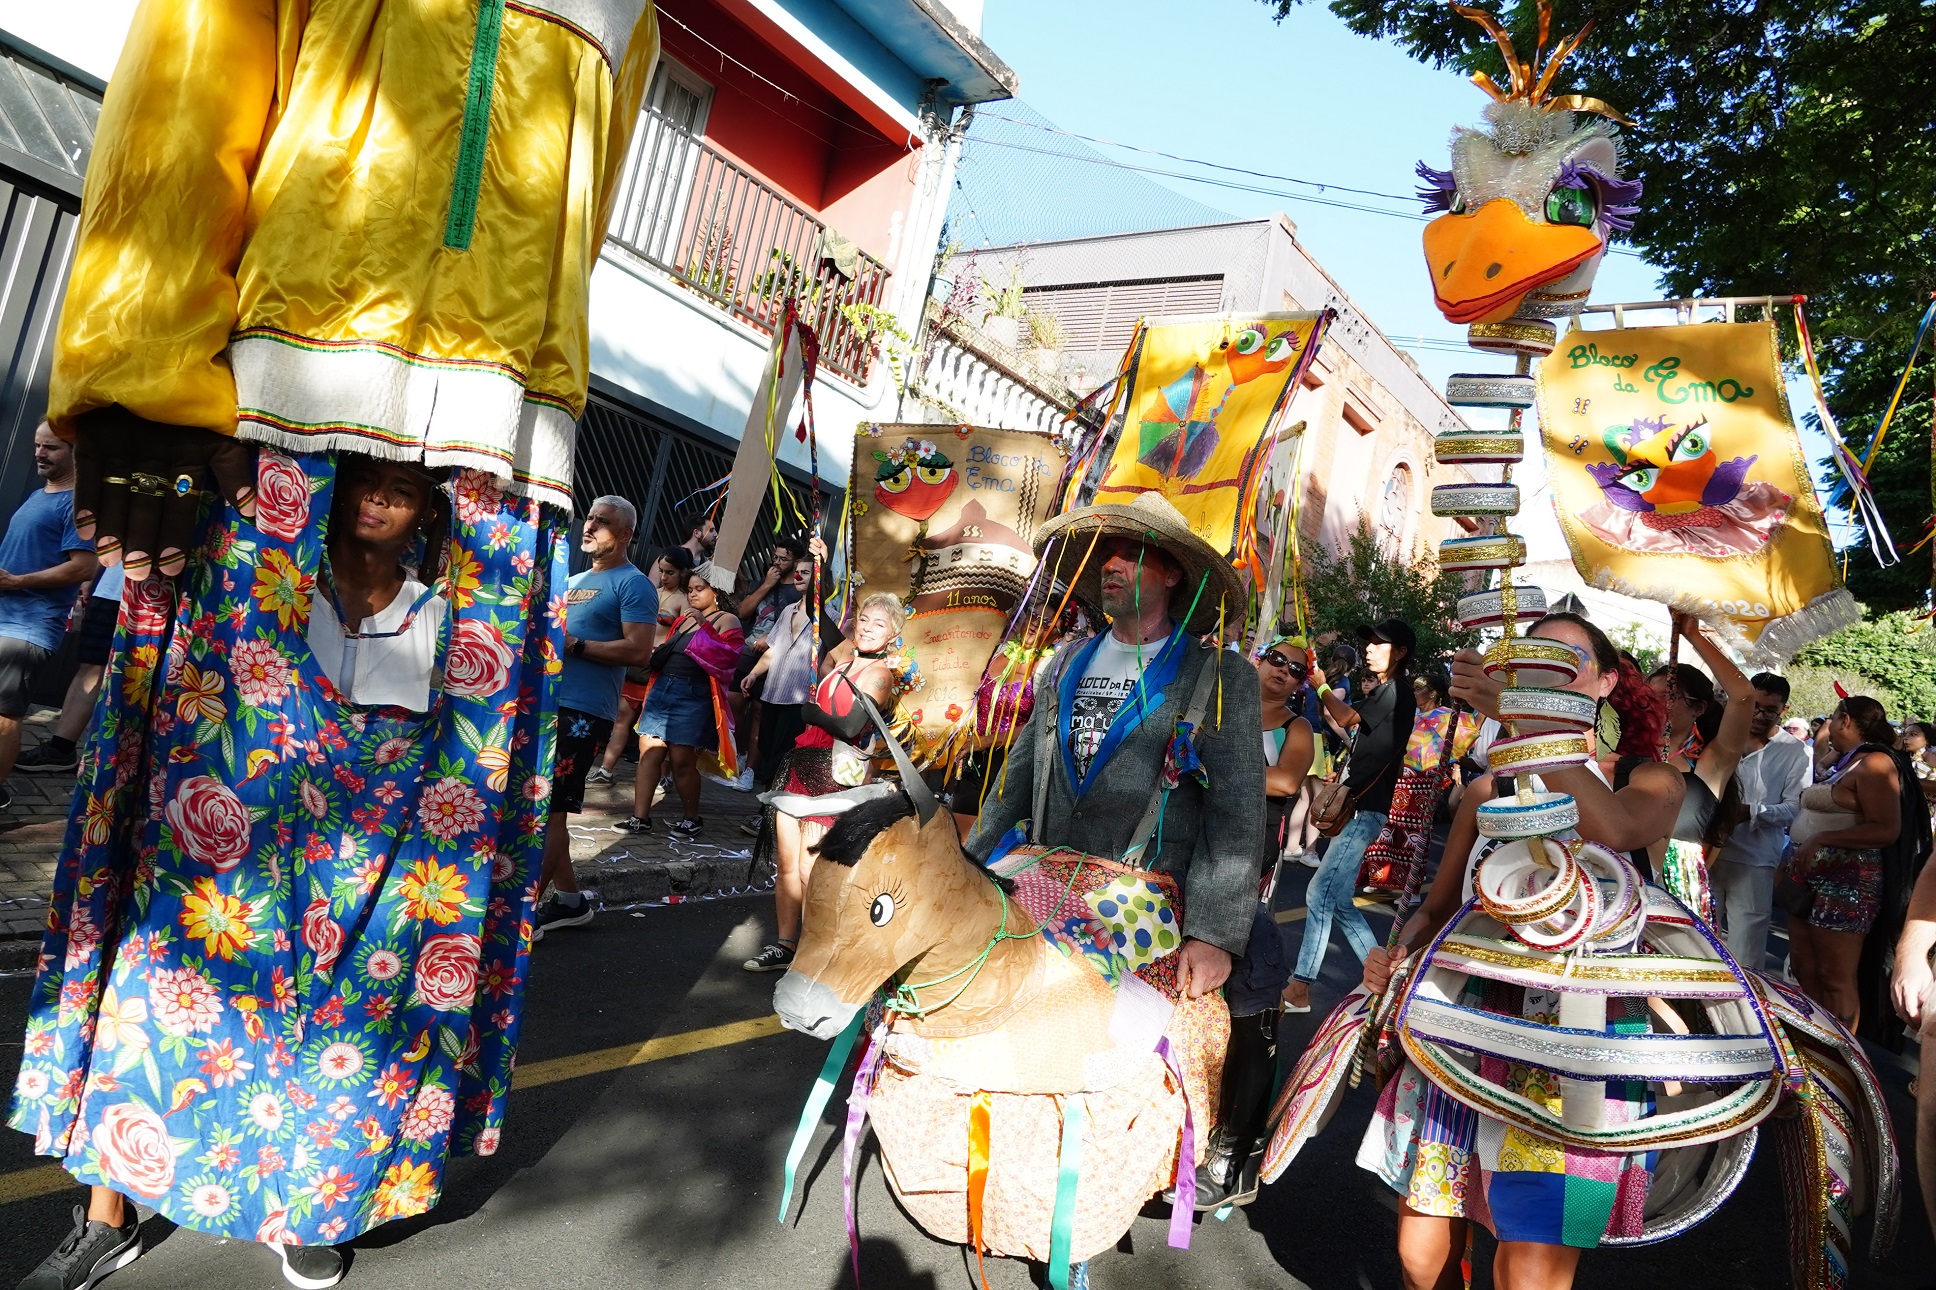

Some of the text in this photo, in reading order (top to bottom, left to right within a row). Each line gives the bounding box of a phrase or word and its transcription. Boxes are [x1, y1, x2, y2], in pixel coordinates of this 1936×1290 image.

[1568, 343, 1638, 368] Bloco
[1613, 357, 1754, 404] da Ema
[966, 446, 1051, 476] Bloco da
[966, 467, 1016, 491] Ema
[947, 590, 998, 607] 11 anos
[924, 625, 993, 645] Encantando
[947, 647, 955, 655] a
[932, 656, 972, 671] Cidade
[926, 686, 958, 703] 2016
